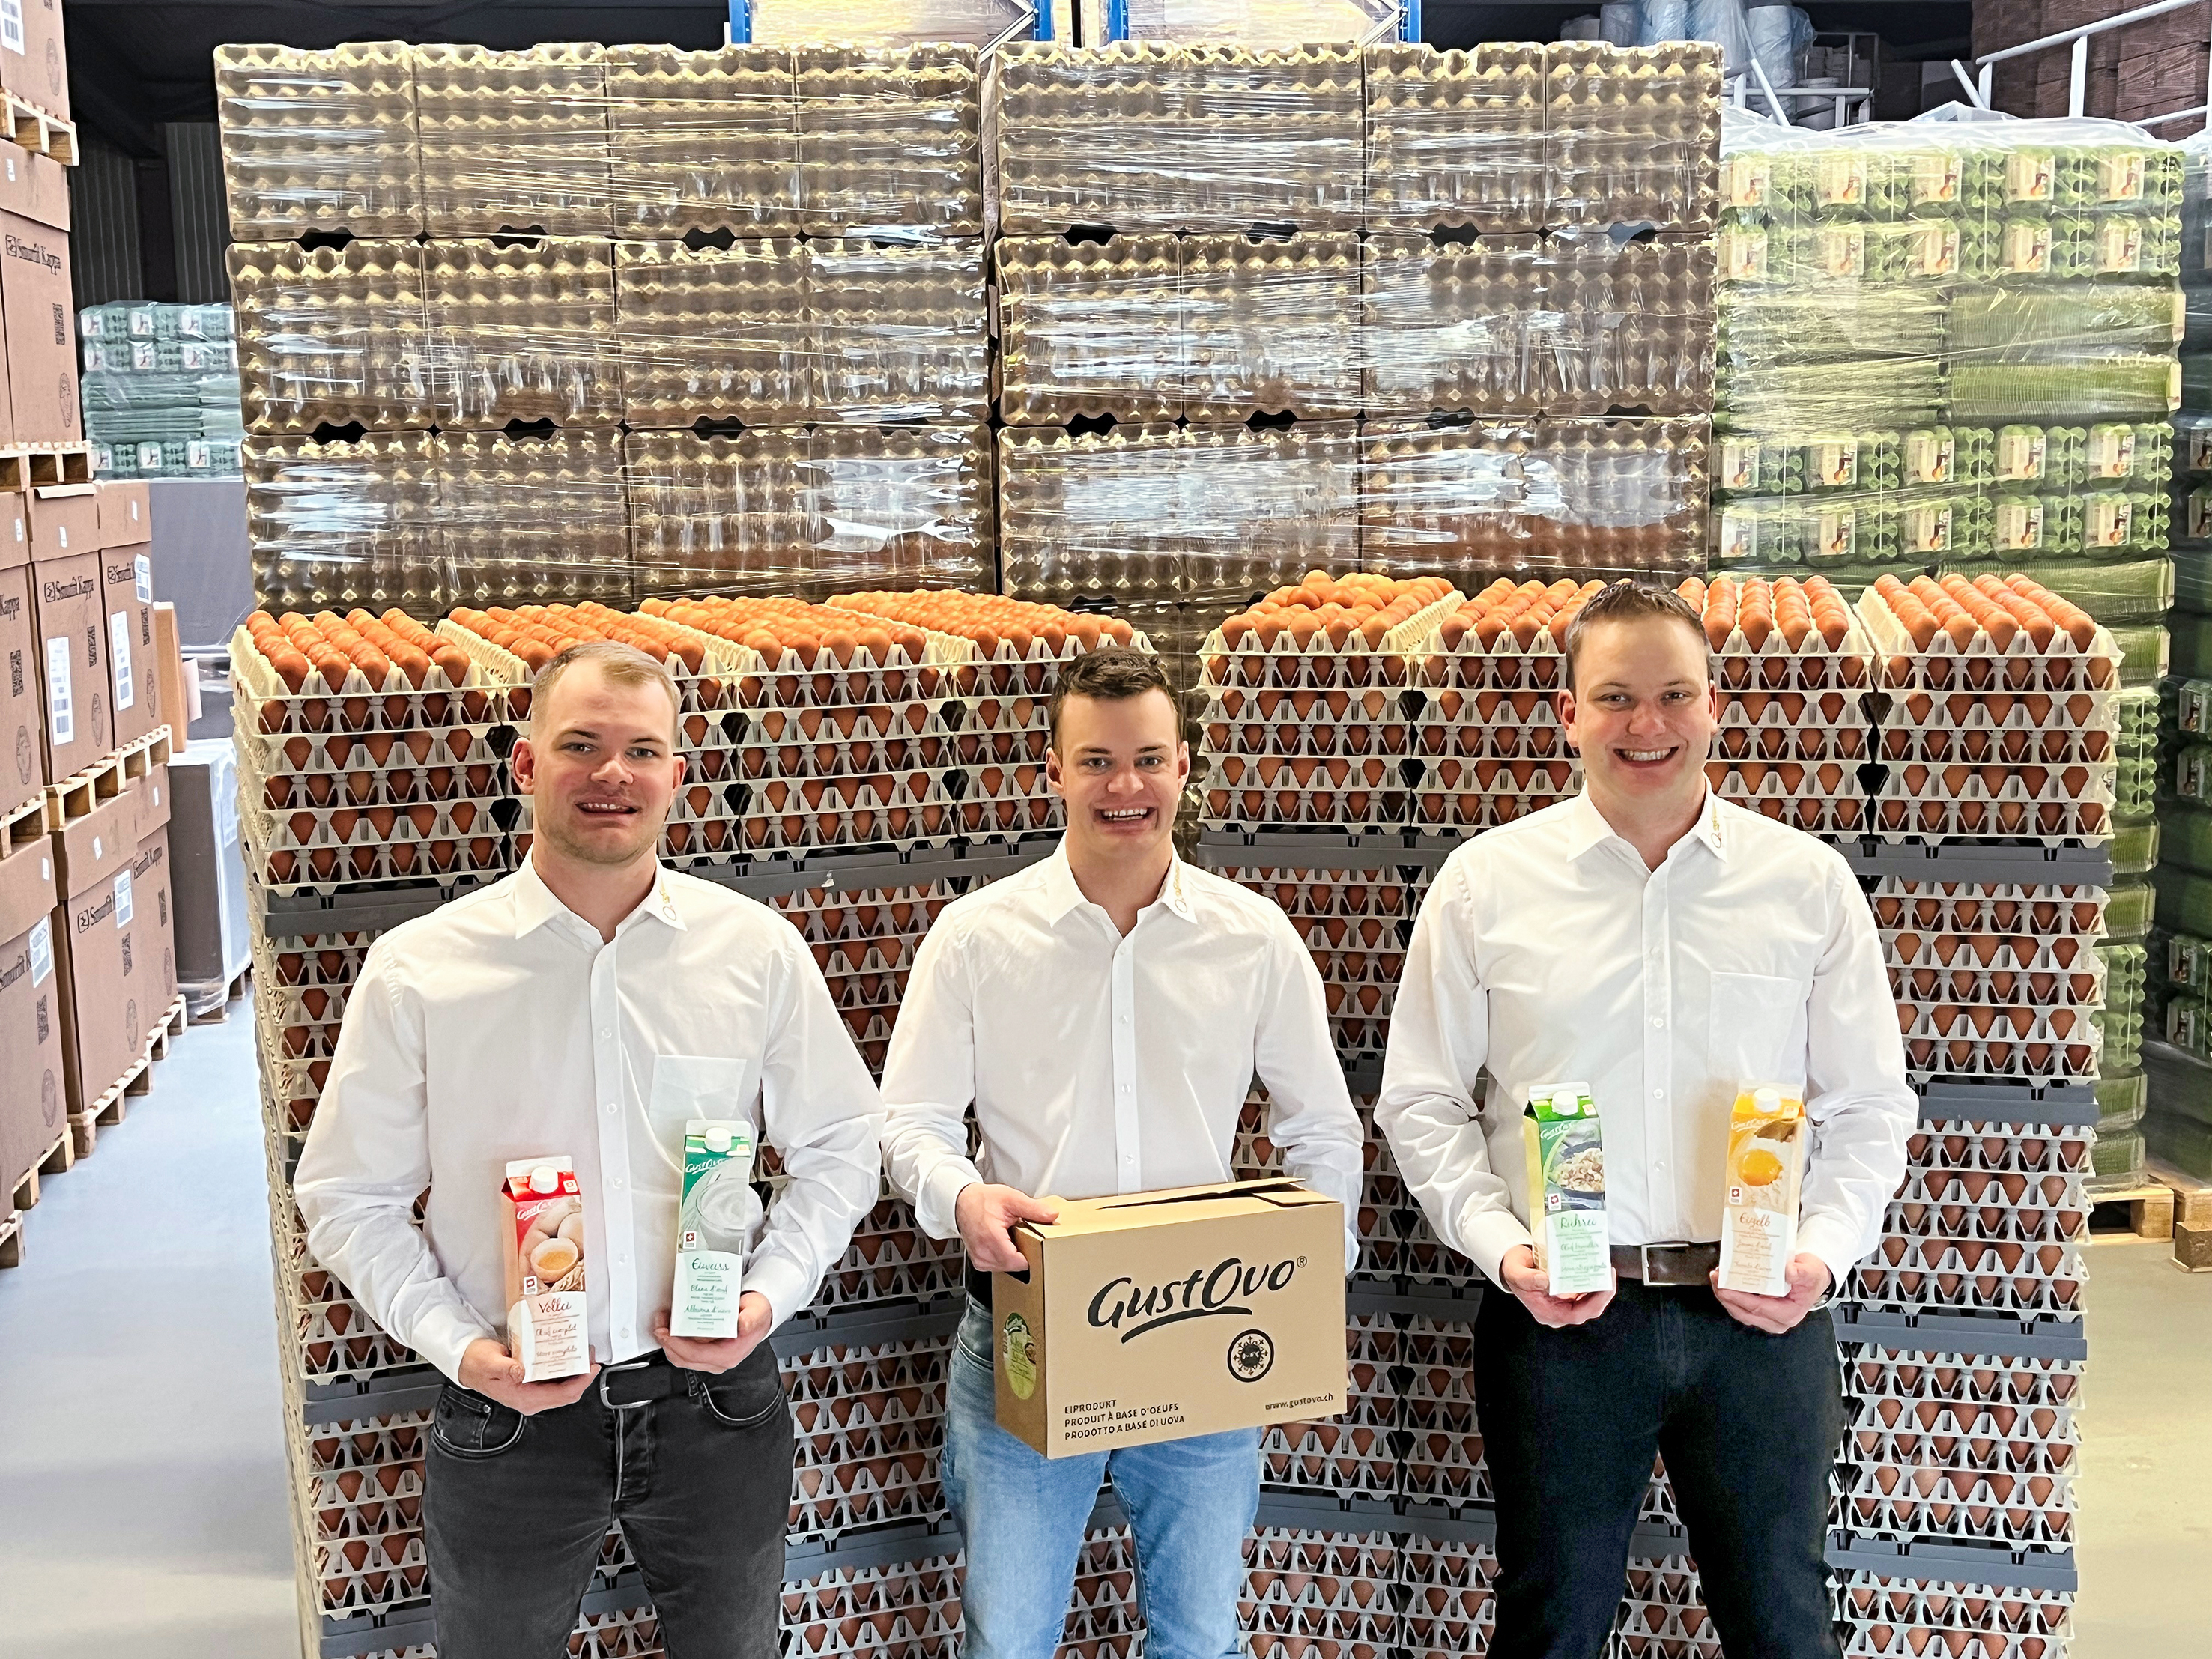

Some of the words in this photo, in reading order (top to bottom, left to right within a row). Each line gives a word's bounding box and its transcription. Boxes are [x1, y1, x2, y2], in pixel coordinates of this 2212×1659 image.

[1064, 1399, 1116, 1414] EIPRODUKT
[1064, 1413, 1106, 1428] PRODUIT
[1108, 1411, 1114, 1421] À
[1116, 1409, 1137, 1420] BASE
[1141, 1403, 1178, 1416] D'OEUFS
[1064, 1425, 1115, 1440] PRODOTTO
[1125, 1420, 1147, 1431] BASE
[1149, 1419, 1159, 1428] DI
[1161, 1416, 1184, 1426] UOVA
